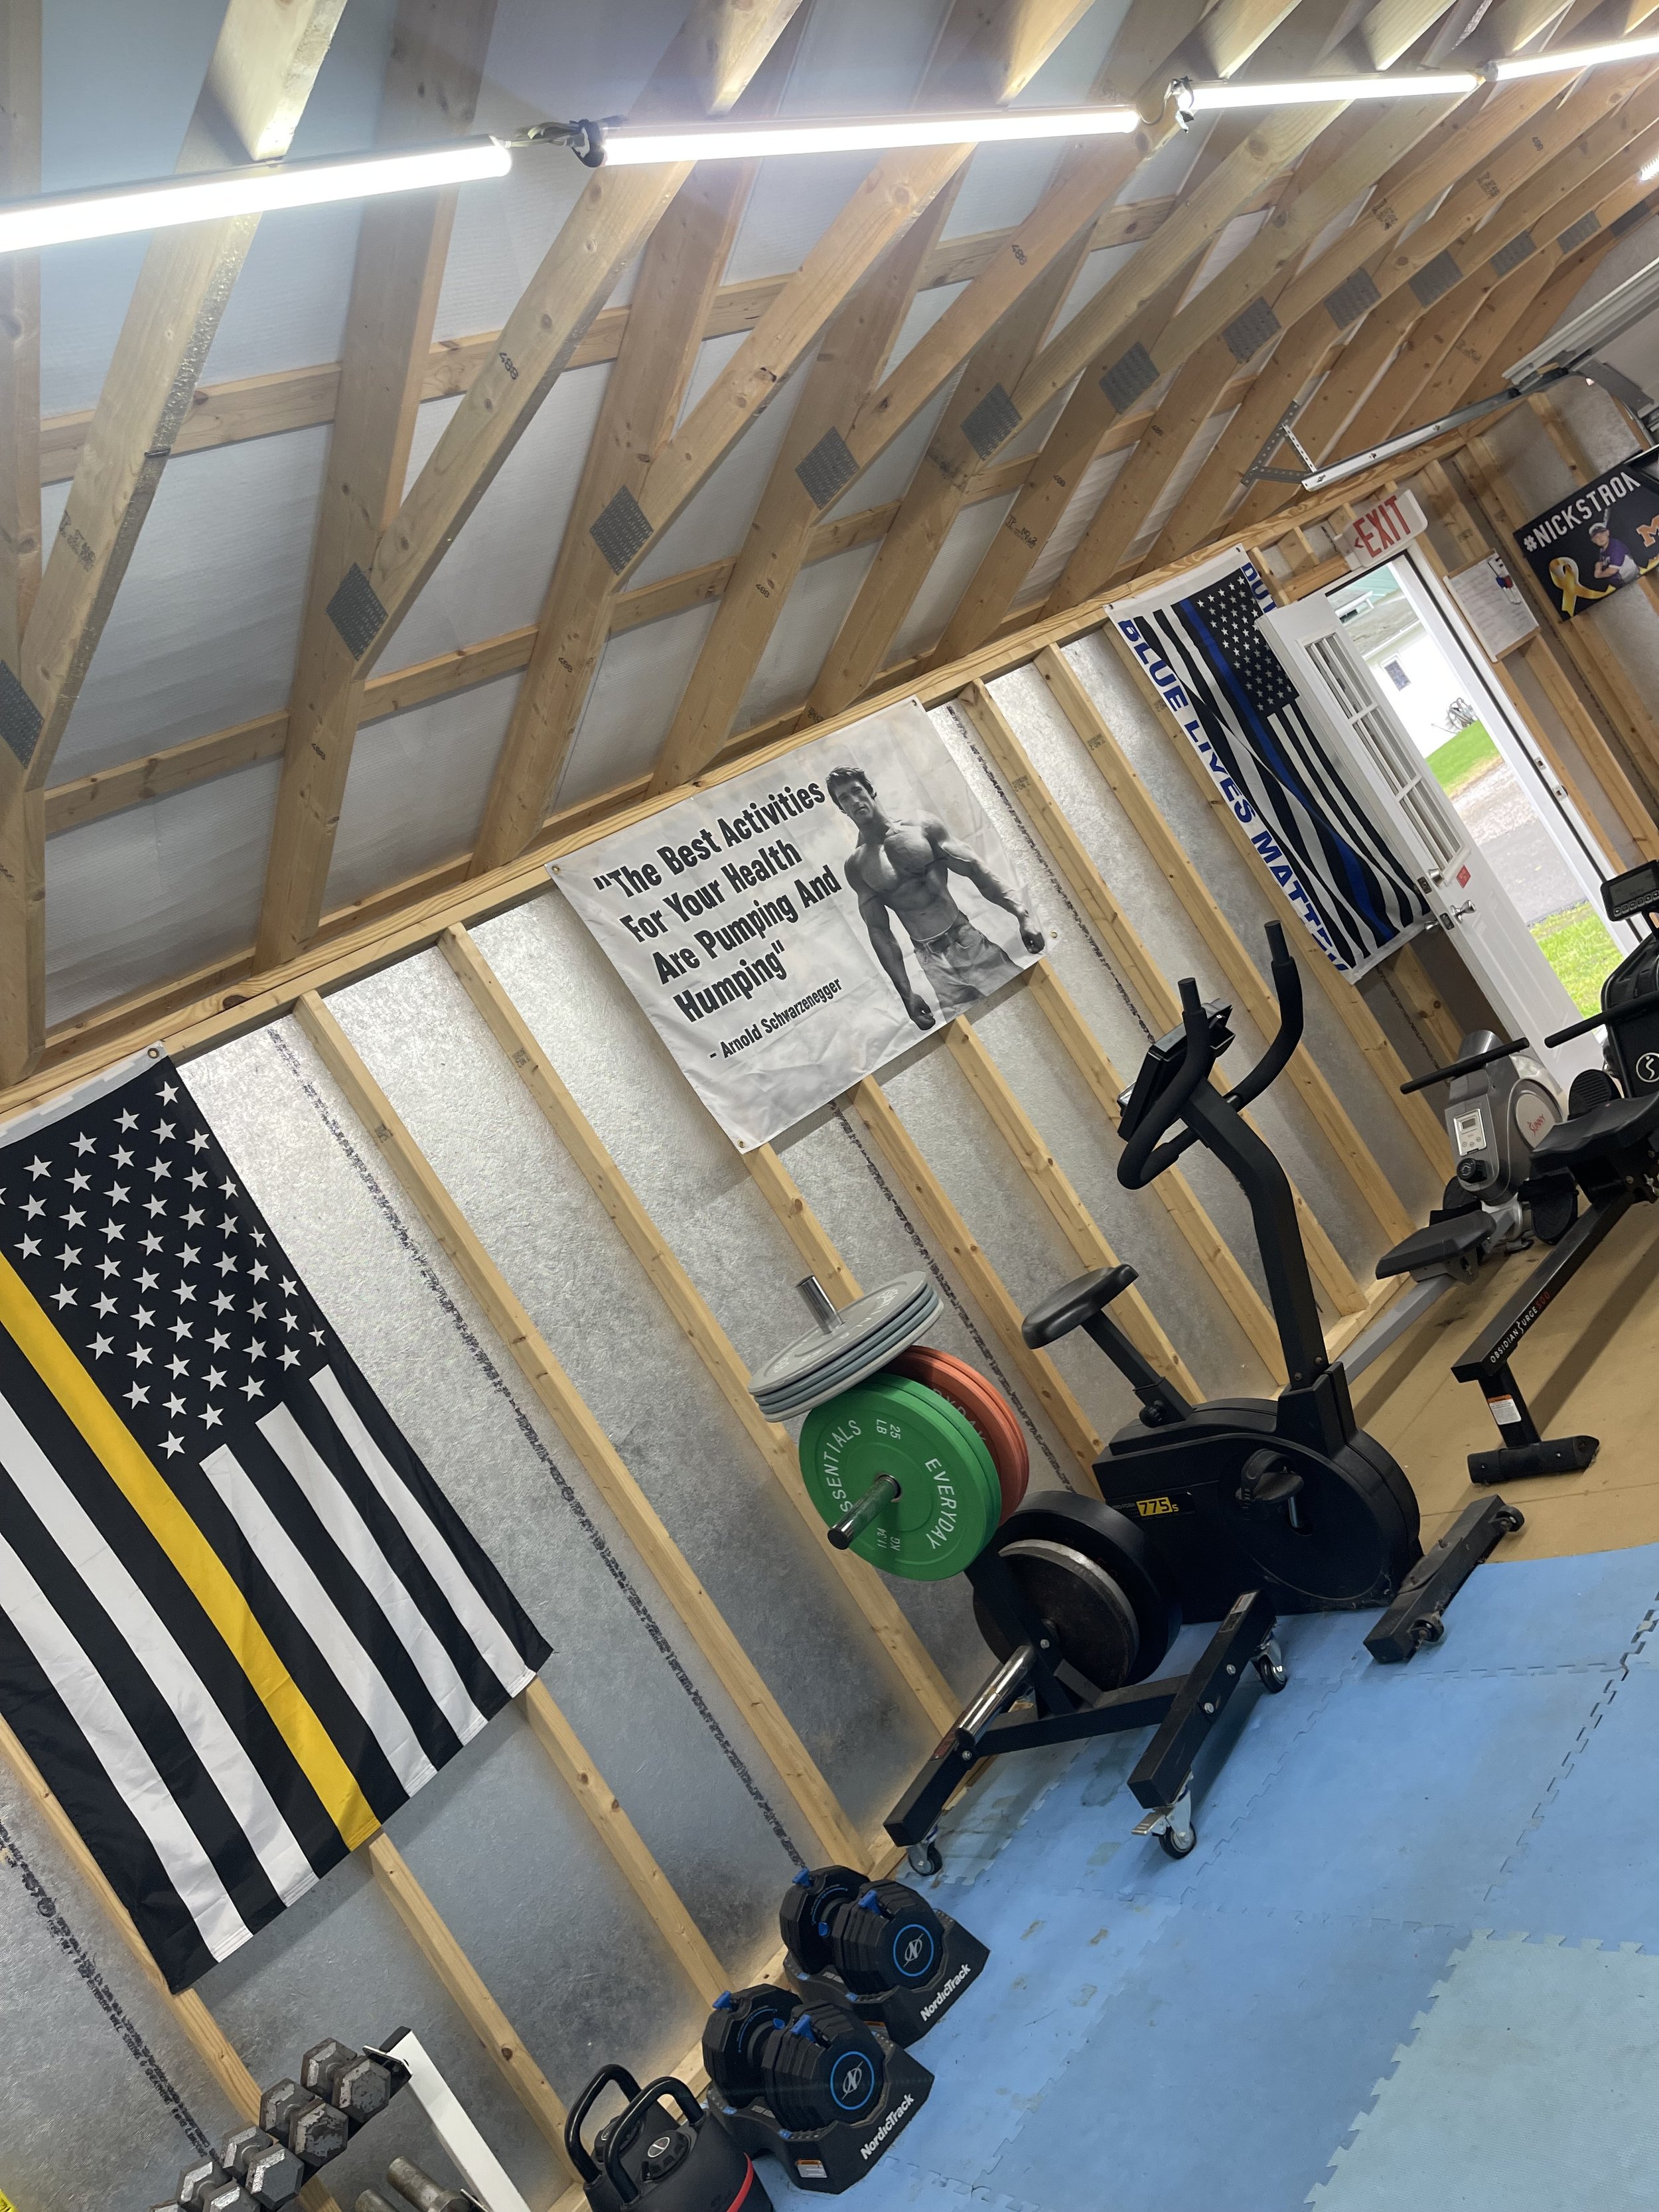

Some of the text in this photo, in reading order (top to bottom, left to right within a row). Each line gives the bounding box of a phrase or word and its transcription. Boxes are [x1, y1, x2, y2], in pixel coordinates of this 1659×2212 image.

[498, 352, 519, 380] 488
[1353, 496, 1409, 556] EXIT
[755, 583, 770, 598] 488
[558, 657, 573, 673] 488
[1119, 620, 1188, 711] BLUE
[1186, 720, 1255, 822] LIVES
[593, 783, 825, 897] "The Best Activities
[620, 840, 802, 942] For Your Health
[653, 865, 841, 984] Are Pumping And
[673, 940, 786, 1022] Humping"
[721, 1024, 762, 1058] Arnold
[1491, 1329, 1518, 1363] OBSIDIAN
[877, 1420, 887, 1434] LB
[891, 1424, 901, 1439] 25
[824, 1420, 861, 1512] SSENTIALS
[925, 1459, 956, 1548] EVERYDAY
[891, 1537, 900, 1550] KG
[921, 1964, 970, 2021] NordicTrack
[861, 2095, 914, 2159] NordicTrack
